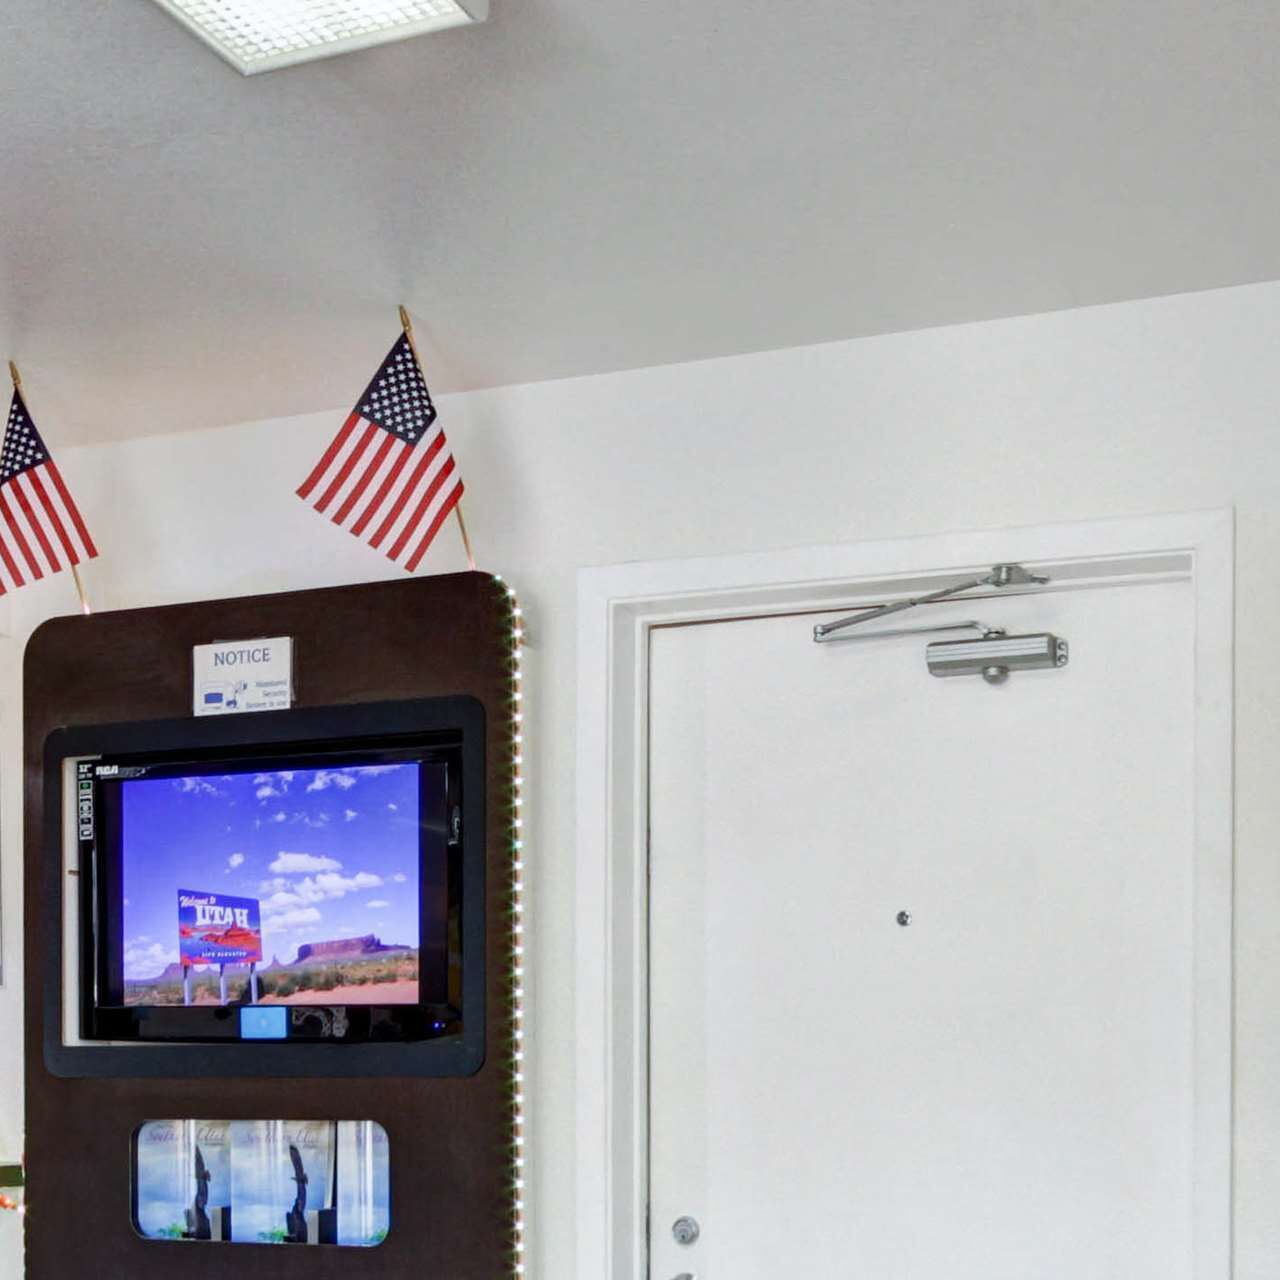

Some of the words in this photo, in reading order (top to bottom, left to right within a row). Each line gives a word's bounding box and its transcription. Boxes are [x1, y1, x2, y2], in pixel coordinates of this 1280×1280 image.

[214, 647, 271, 666] NOTICE
[96, 765, 118, 775] RCA
[195, 904, 249, 928] UTAH
